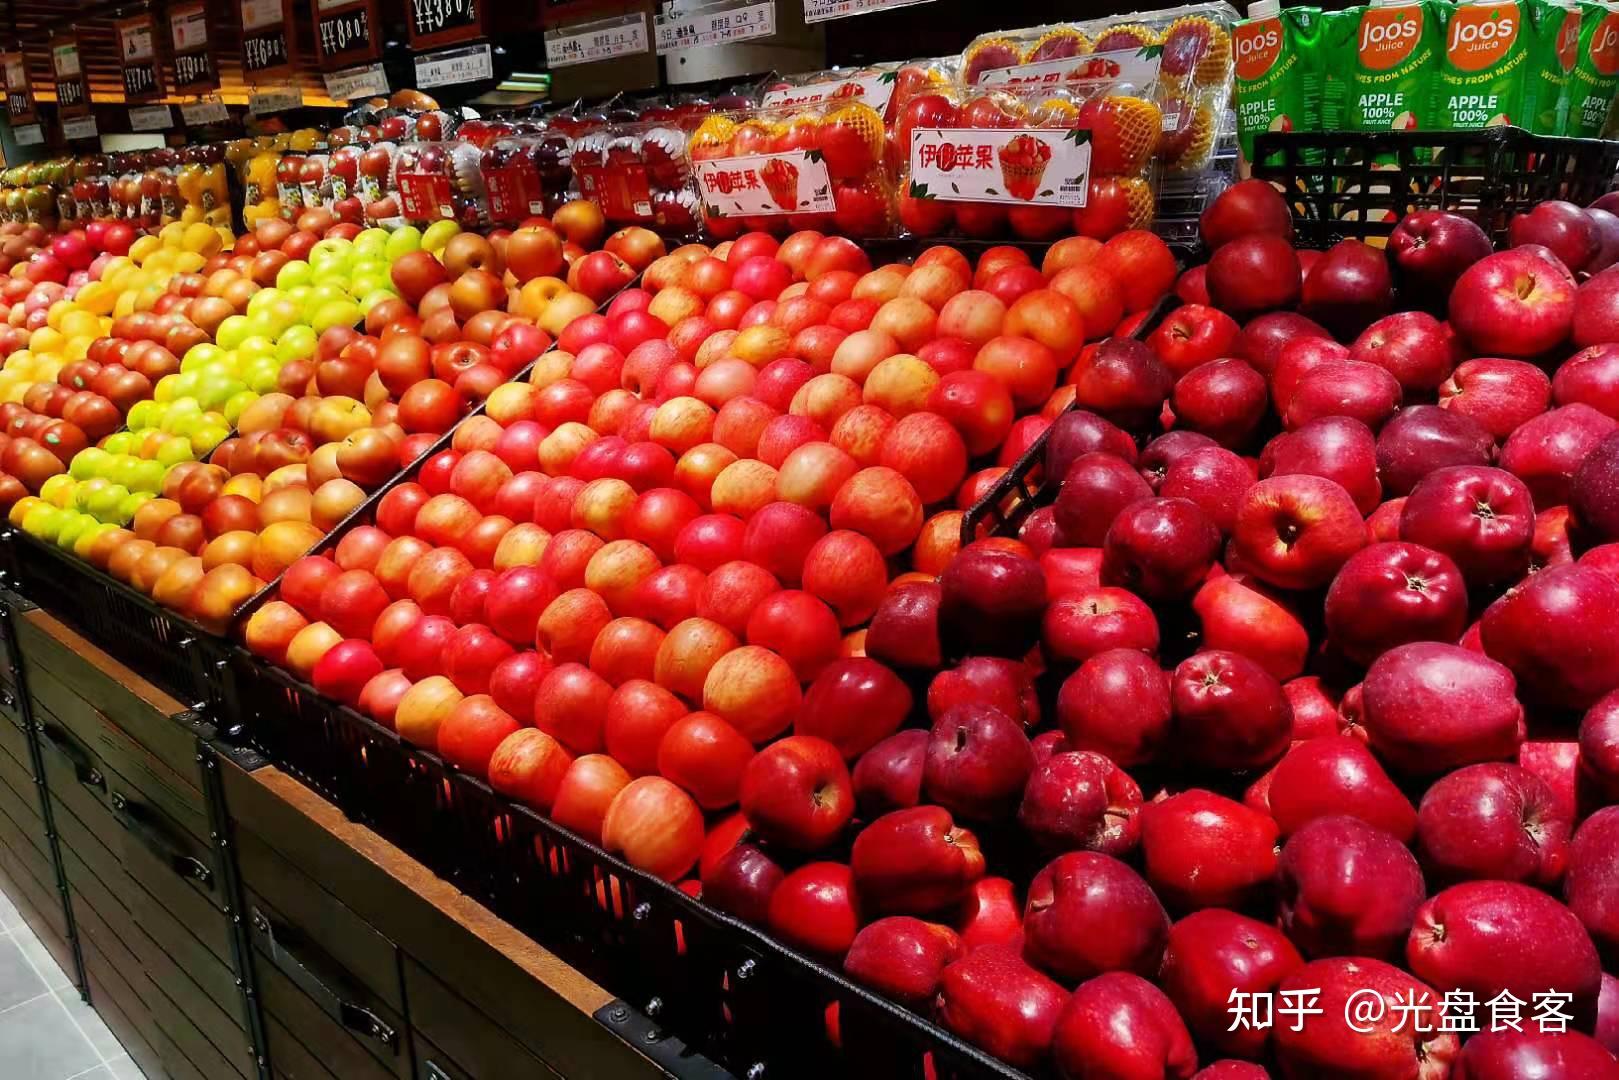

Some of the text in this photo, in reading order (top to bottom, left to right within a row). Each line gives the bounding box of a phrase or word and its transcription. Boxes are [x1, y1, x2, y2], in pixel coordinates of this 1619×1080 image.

[1376, 40, 1404, 52] Juice
[1467, 41, 1499, 52] Juice
[1465, 72, 1494, 85] FROM
[1358, 93, 1404, 107] APPLE
[1447, 95, 1498, 109] APPLE
[1239, 98, 1276, 116] APPLE
[1362, 107, 1395, 119] 100%
[1243, 112, 1270, 126] 100%
[1452, 109, 1488, 122] 100%
